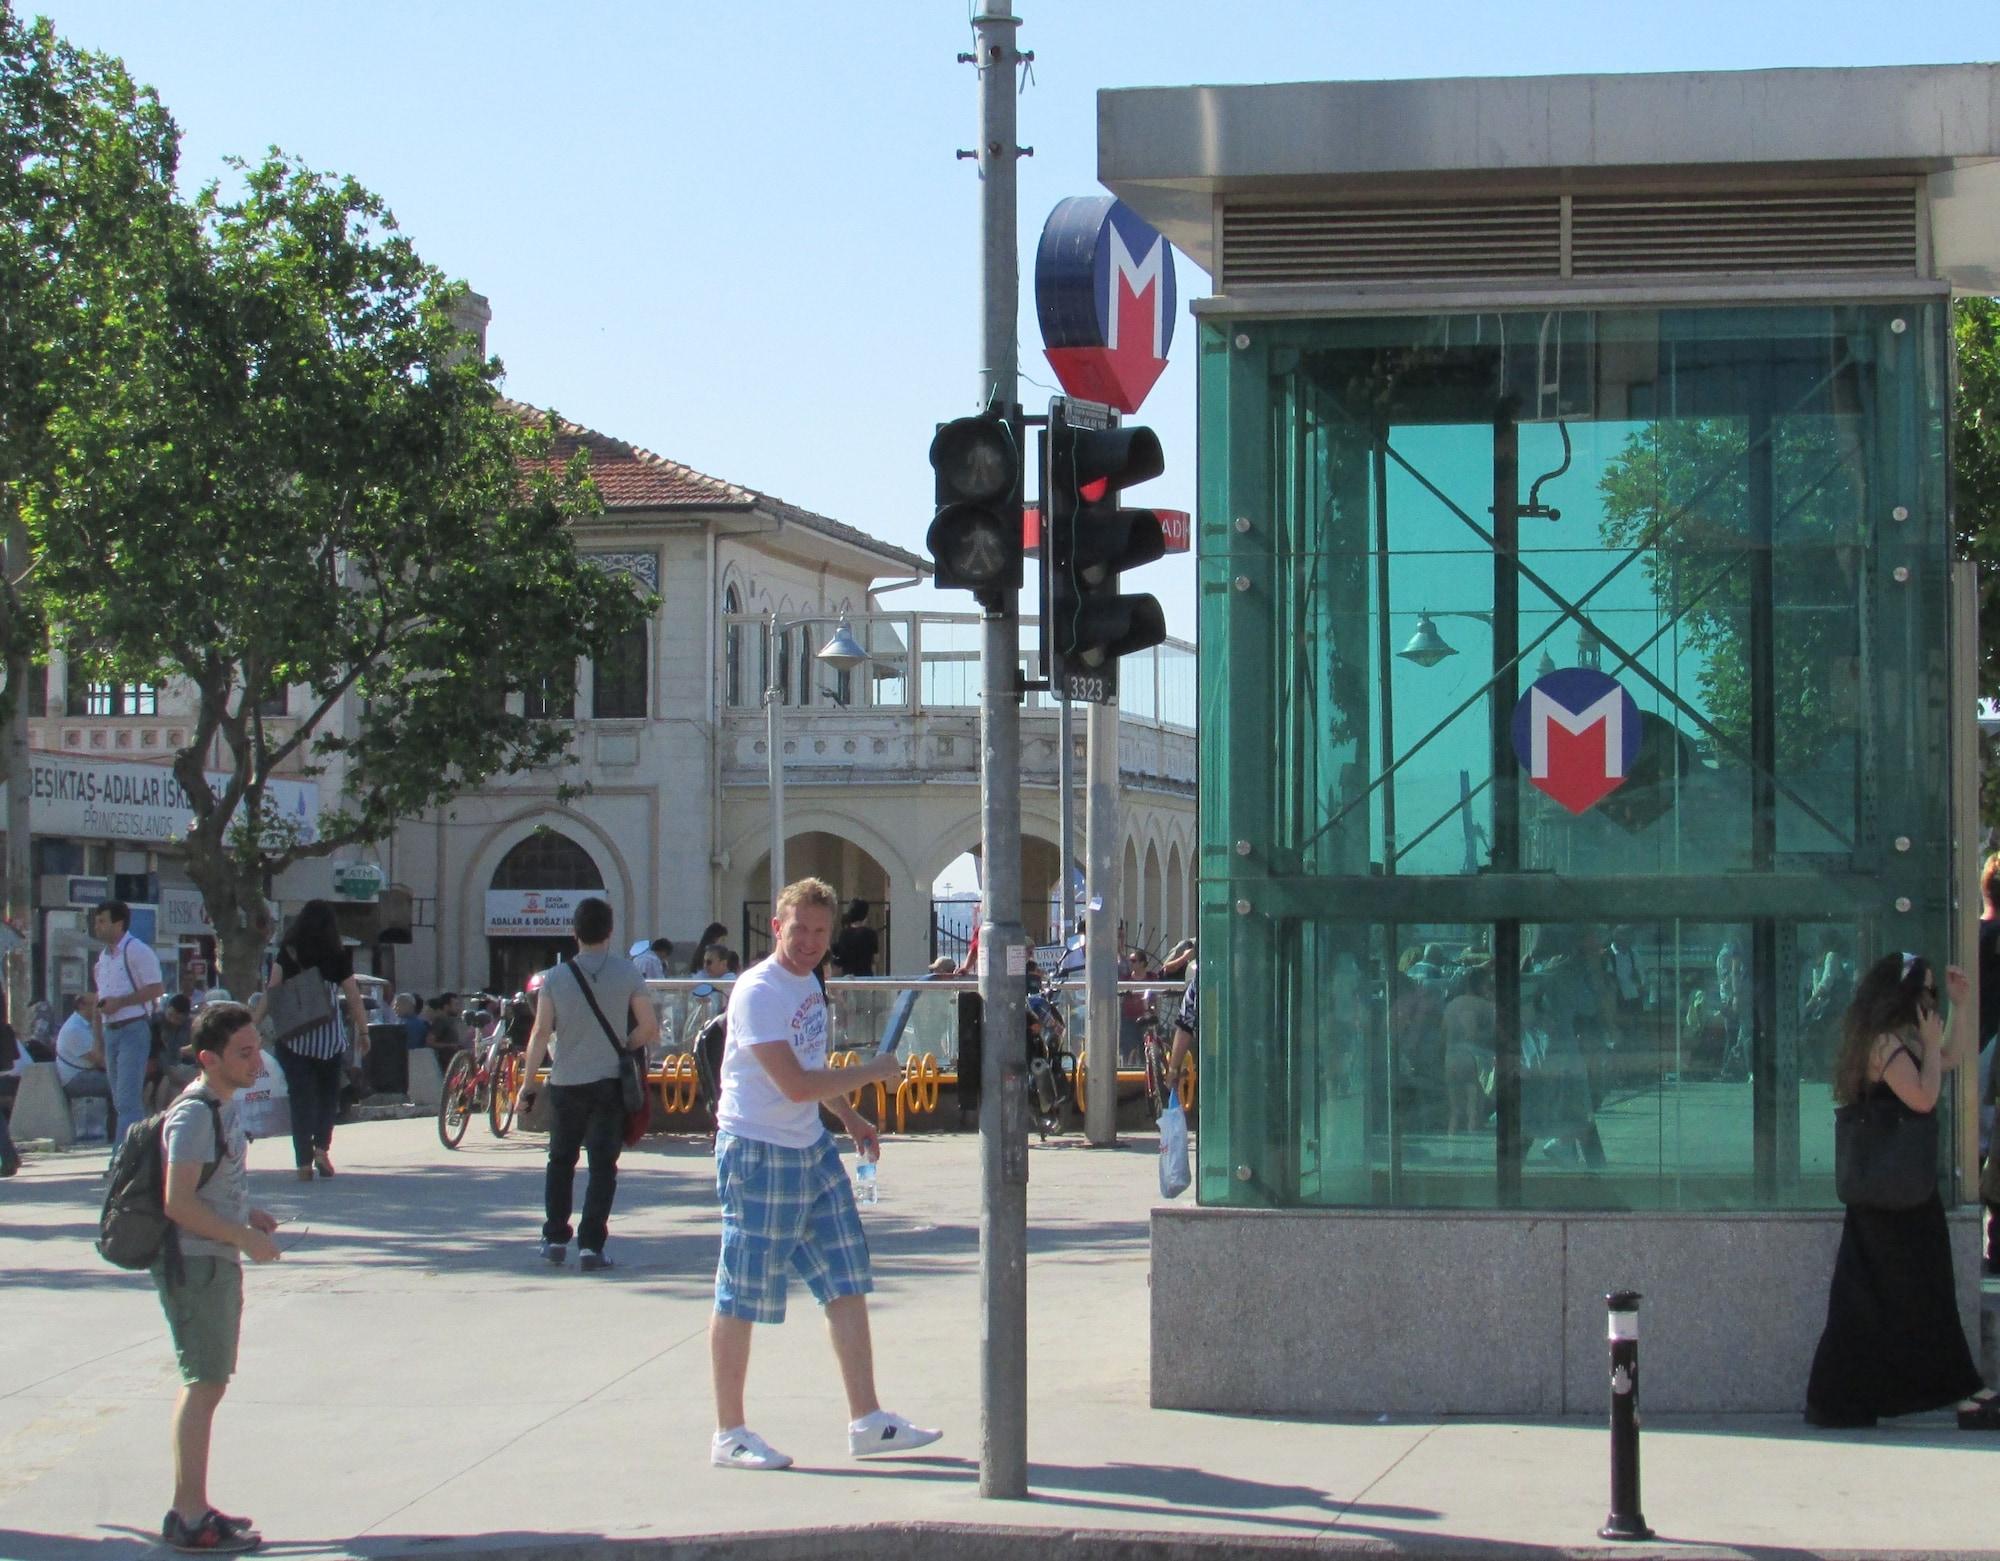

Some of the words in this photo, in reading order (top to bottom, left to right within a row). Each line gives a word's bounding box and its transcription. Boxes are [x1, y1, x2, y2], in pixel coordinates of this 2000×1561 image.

[1108, 220, 1163, 359] M
[1070, 676, 1103, 701] 3323
[1531, 685, 1623, 778] M
[30, 763, 160, 811] EŞİKTAŞ-ADALAR
[491, 917, 522, 926] ADALAR
